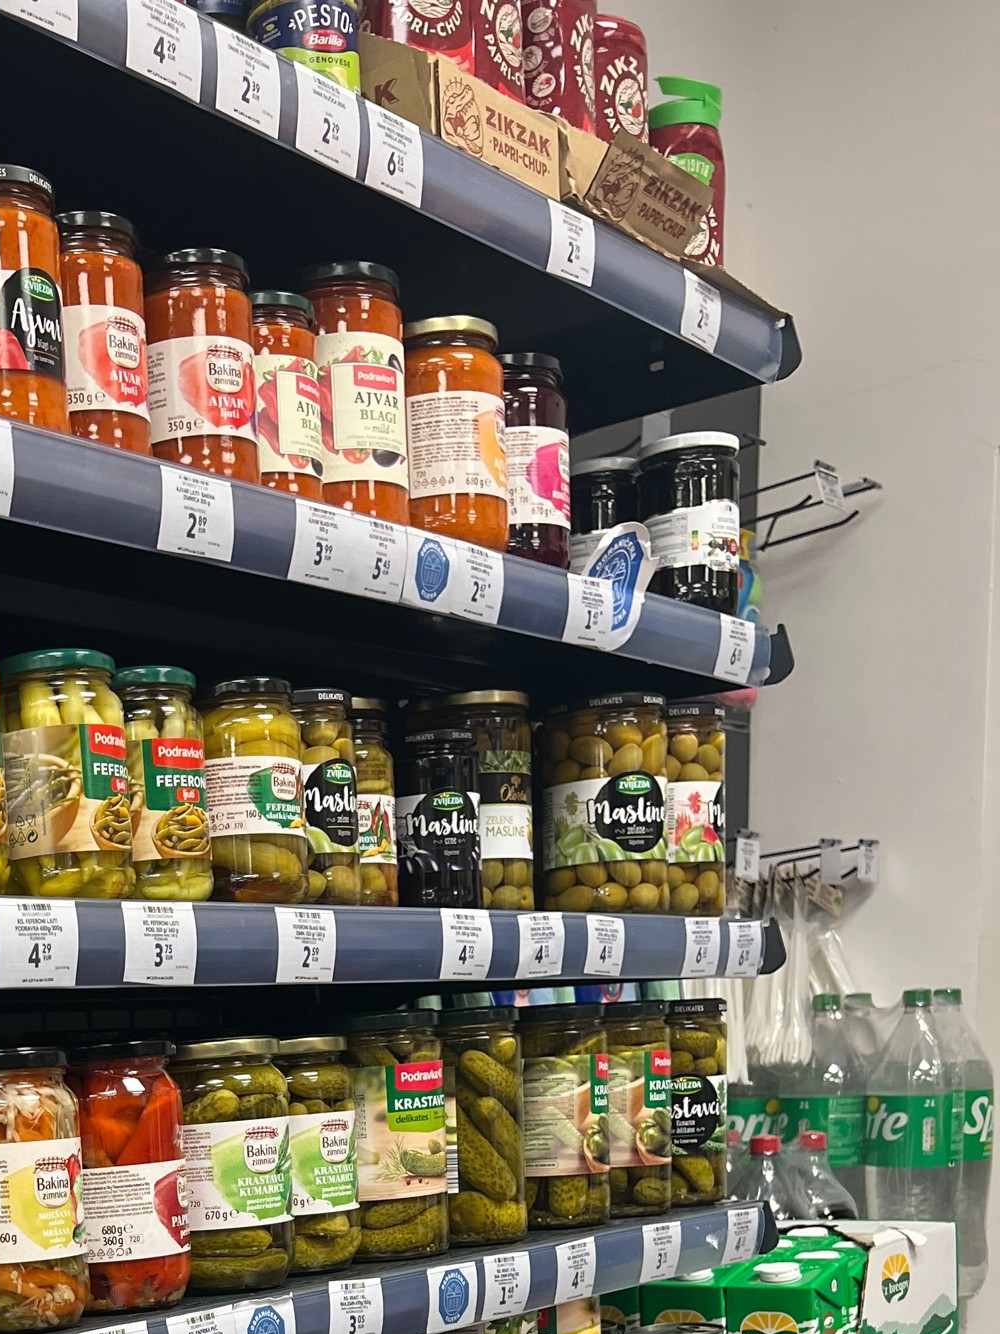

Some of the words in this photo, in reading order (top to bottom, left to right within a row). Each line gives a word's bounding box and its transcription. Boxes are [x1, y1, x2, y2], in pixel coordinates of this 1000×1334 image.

[295, 6, 349, 33] PESTO
[309, 32, 343, 47] Barilla
[153, 38, 166, 64] 4
[309, 56, 350, 69] GENOVESE
[485, 105, 551, 156] ZIKZAK
[492, 138, 550, 176] PAPRI-CHUP
[208, 362, 241, 380] Bakina
[213, 374, 240, 388] zimnica
[208, 395, 244, 410] AJVAR
[354, 391, 399, 410] AJVAR
[220, 406, 240, 420] ljuti
[360, 409, 397, 425] BLAGI
[187, 513, 197, 539] 2
[618, 780, 650, 791] ZVIJEZDA
[587, 798, 665, 826] Masline
[485, 826, 525, 838] MASLINE
[154, 944, 164, 967] 3
[237, 1174, 284, 1187] KRASTAVCI
[239, 1184, 284, 1197] KUMARICE
